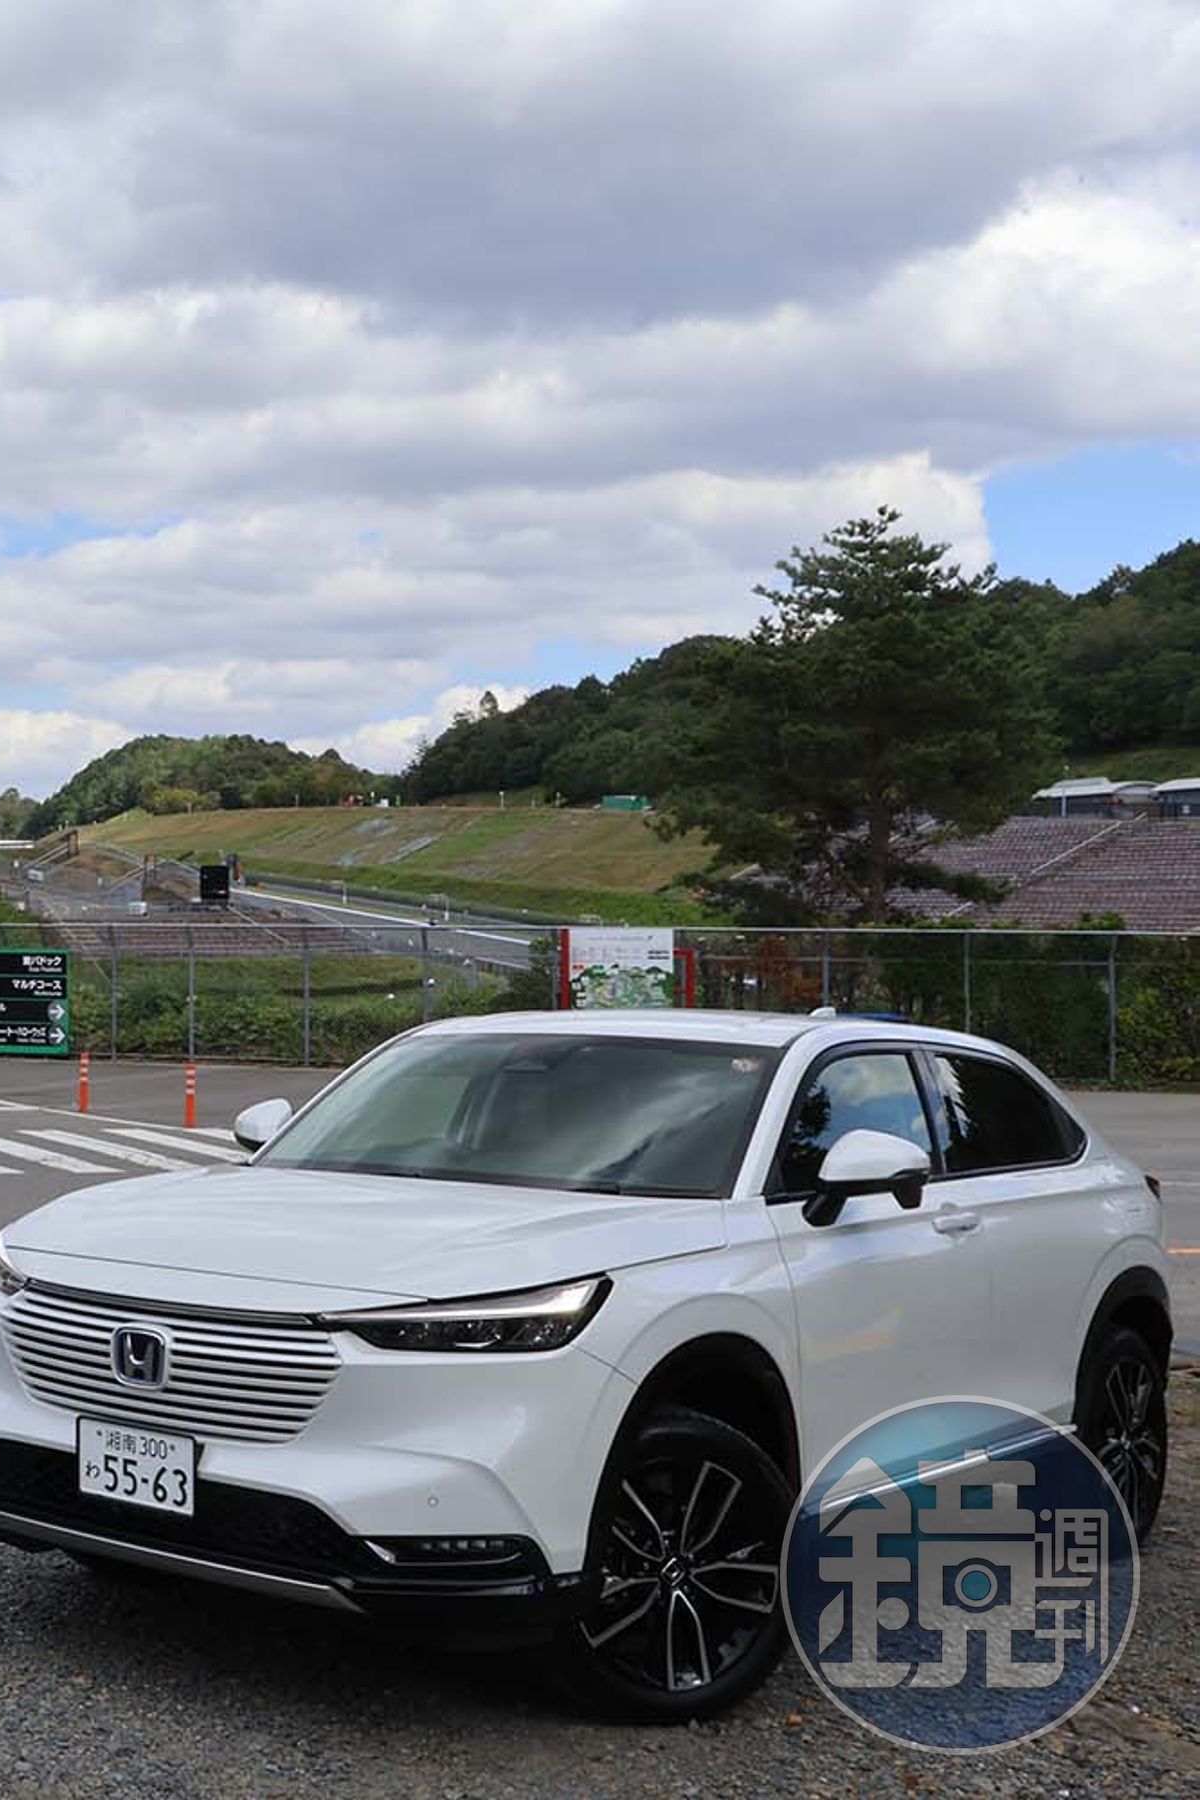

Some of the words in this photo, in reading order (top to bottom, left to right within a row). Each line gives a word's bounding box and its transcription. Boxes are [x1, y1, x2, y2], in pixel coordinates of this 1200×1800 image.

[11, 979, 63, 990] マルチコース
[85, 1461, 100, 1479] わ
[103, 1454, 188, 1507] 55-63
